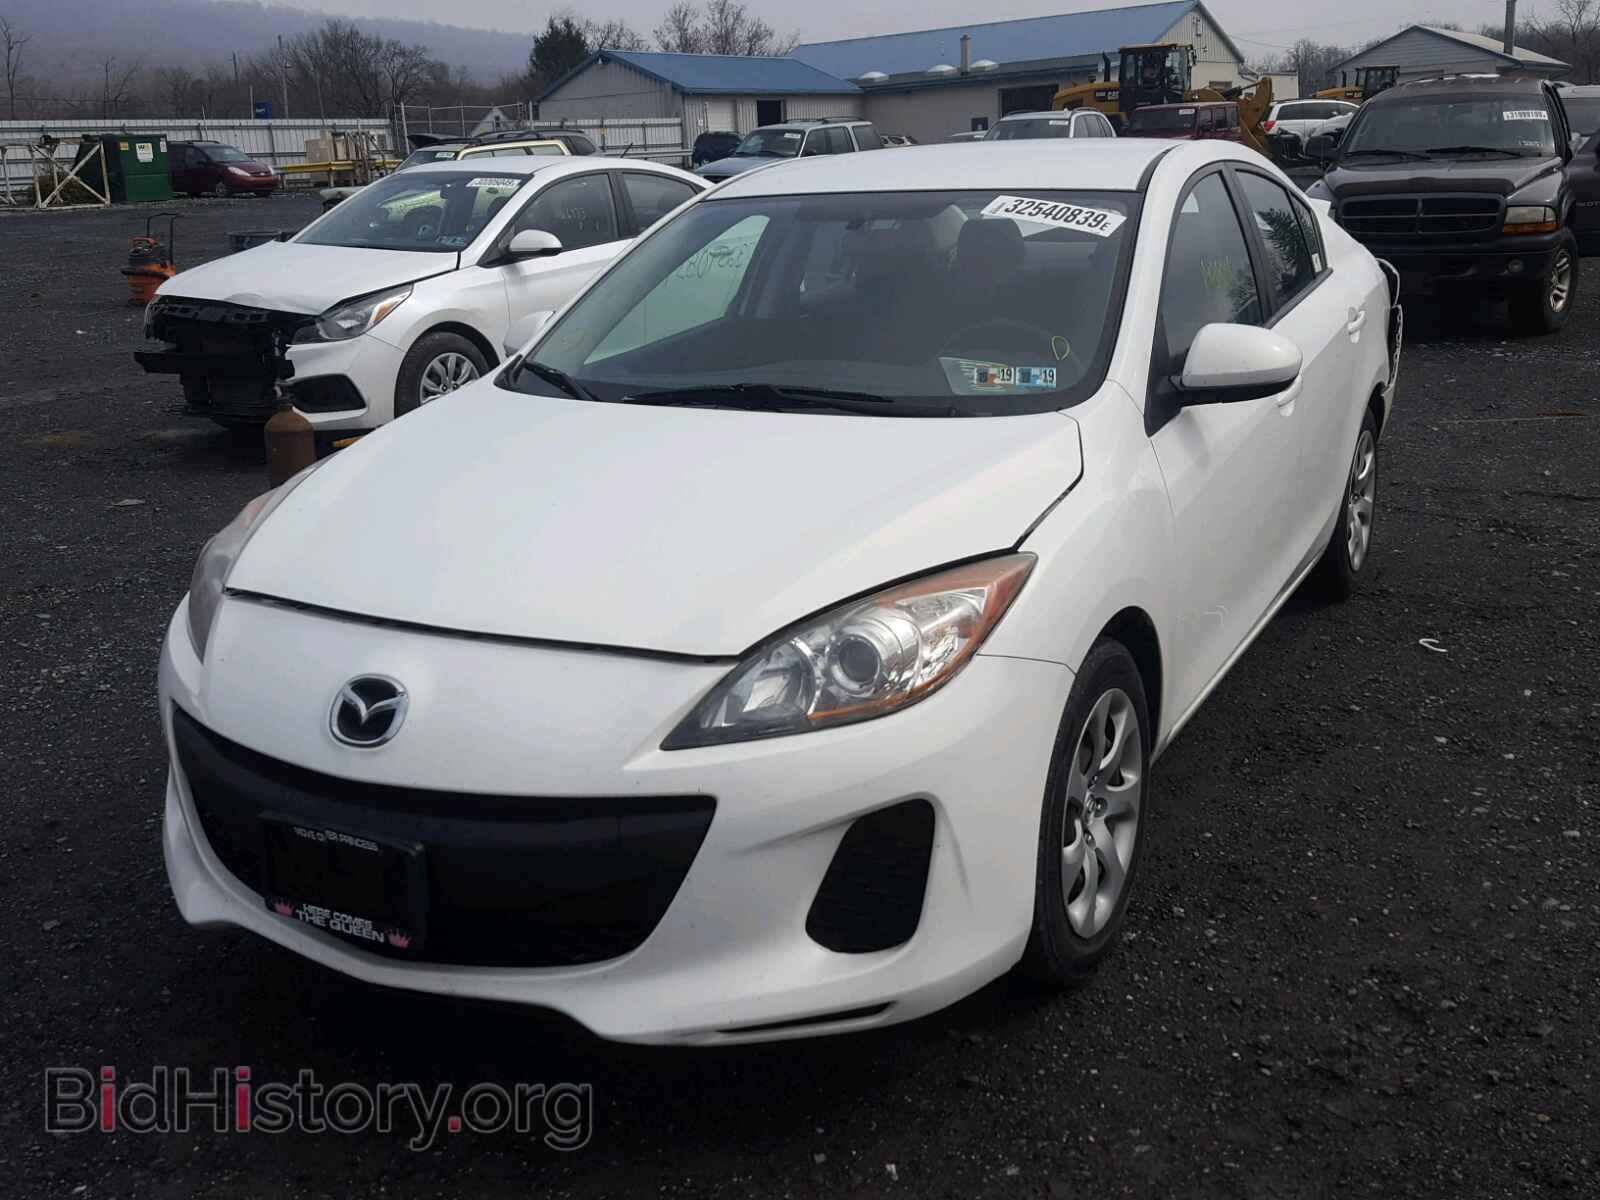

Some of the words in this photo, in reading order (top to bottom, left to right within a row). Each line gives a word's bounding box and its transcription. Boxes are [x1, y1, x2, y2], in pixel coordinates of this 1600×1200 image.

[1000, 368, 1012, 381] 19
[1043, 369, 1055, 381] 19
[296, 910, 326, 927] THE
[329, 921, 385, 943] QUEEN
[303, 904, 331, 919] HERE
[333, 912, 373, 930] COMES
